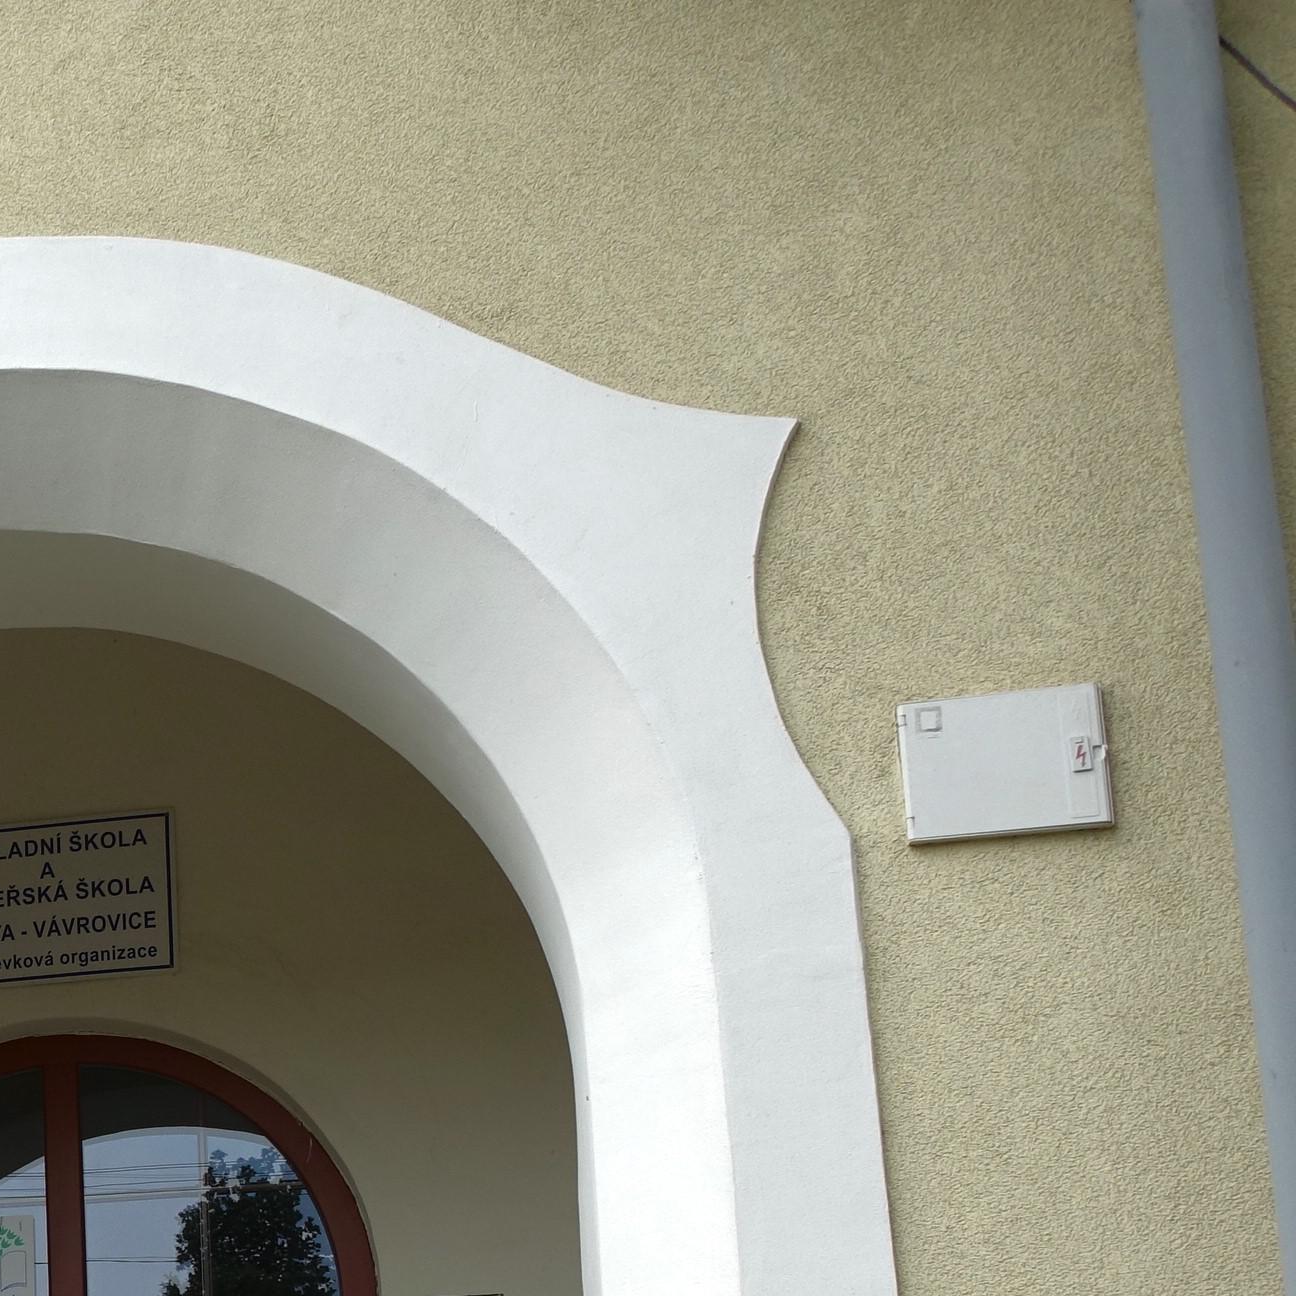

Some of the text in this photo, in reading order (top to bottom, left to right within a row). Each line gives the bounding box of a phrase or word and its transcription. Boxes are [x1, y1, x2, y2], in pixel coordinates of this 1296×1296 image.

[69, 829, 147, 852] ŠKOLA
[40, 862, 55, 879] A
[76, 876, 155, 900] ŠKOLA
[33, 911, 156, 938] VÁVROVICE
[60, 945, 157, 967] organizace
